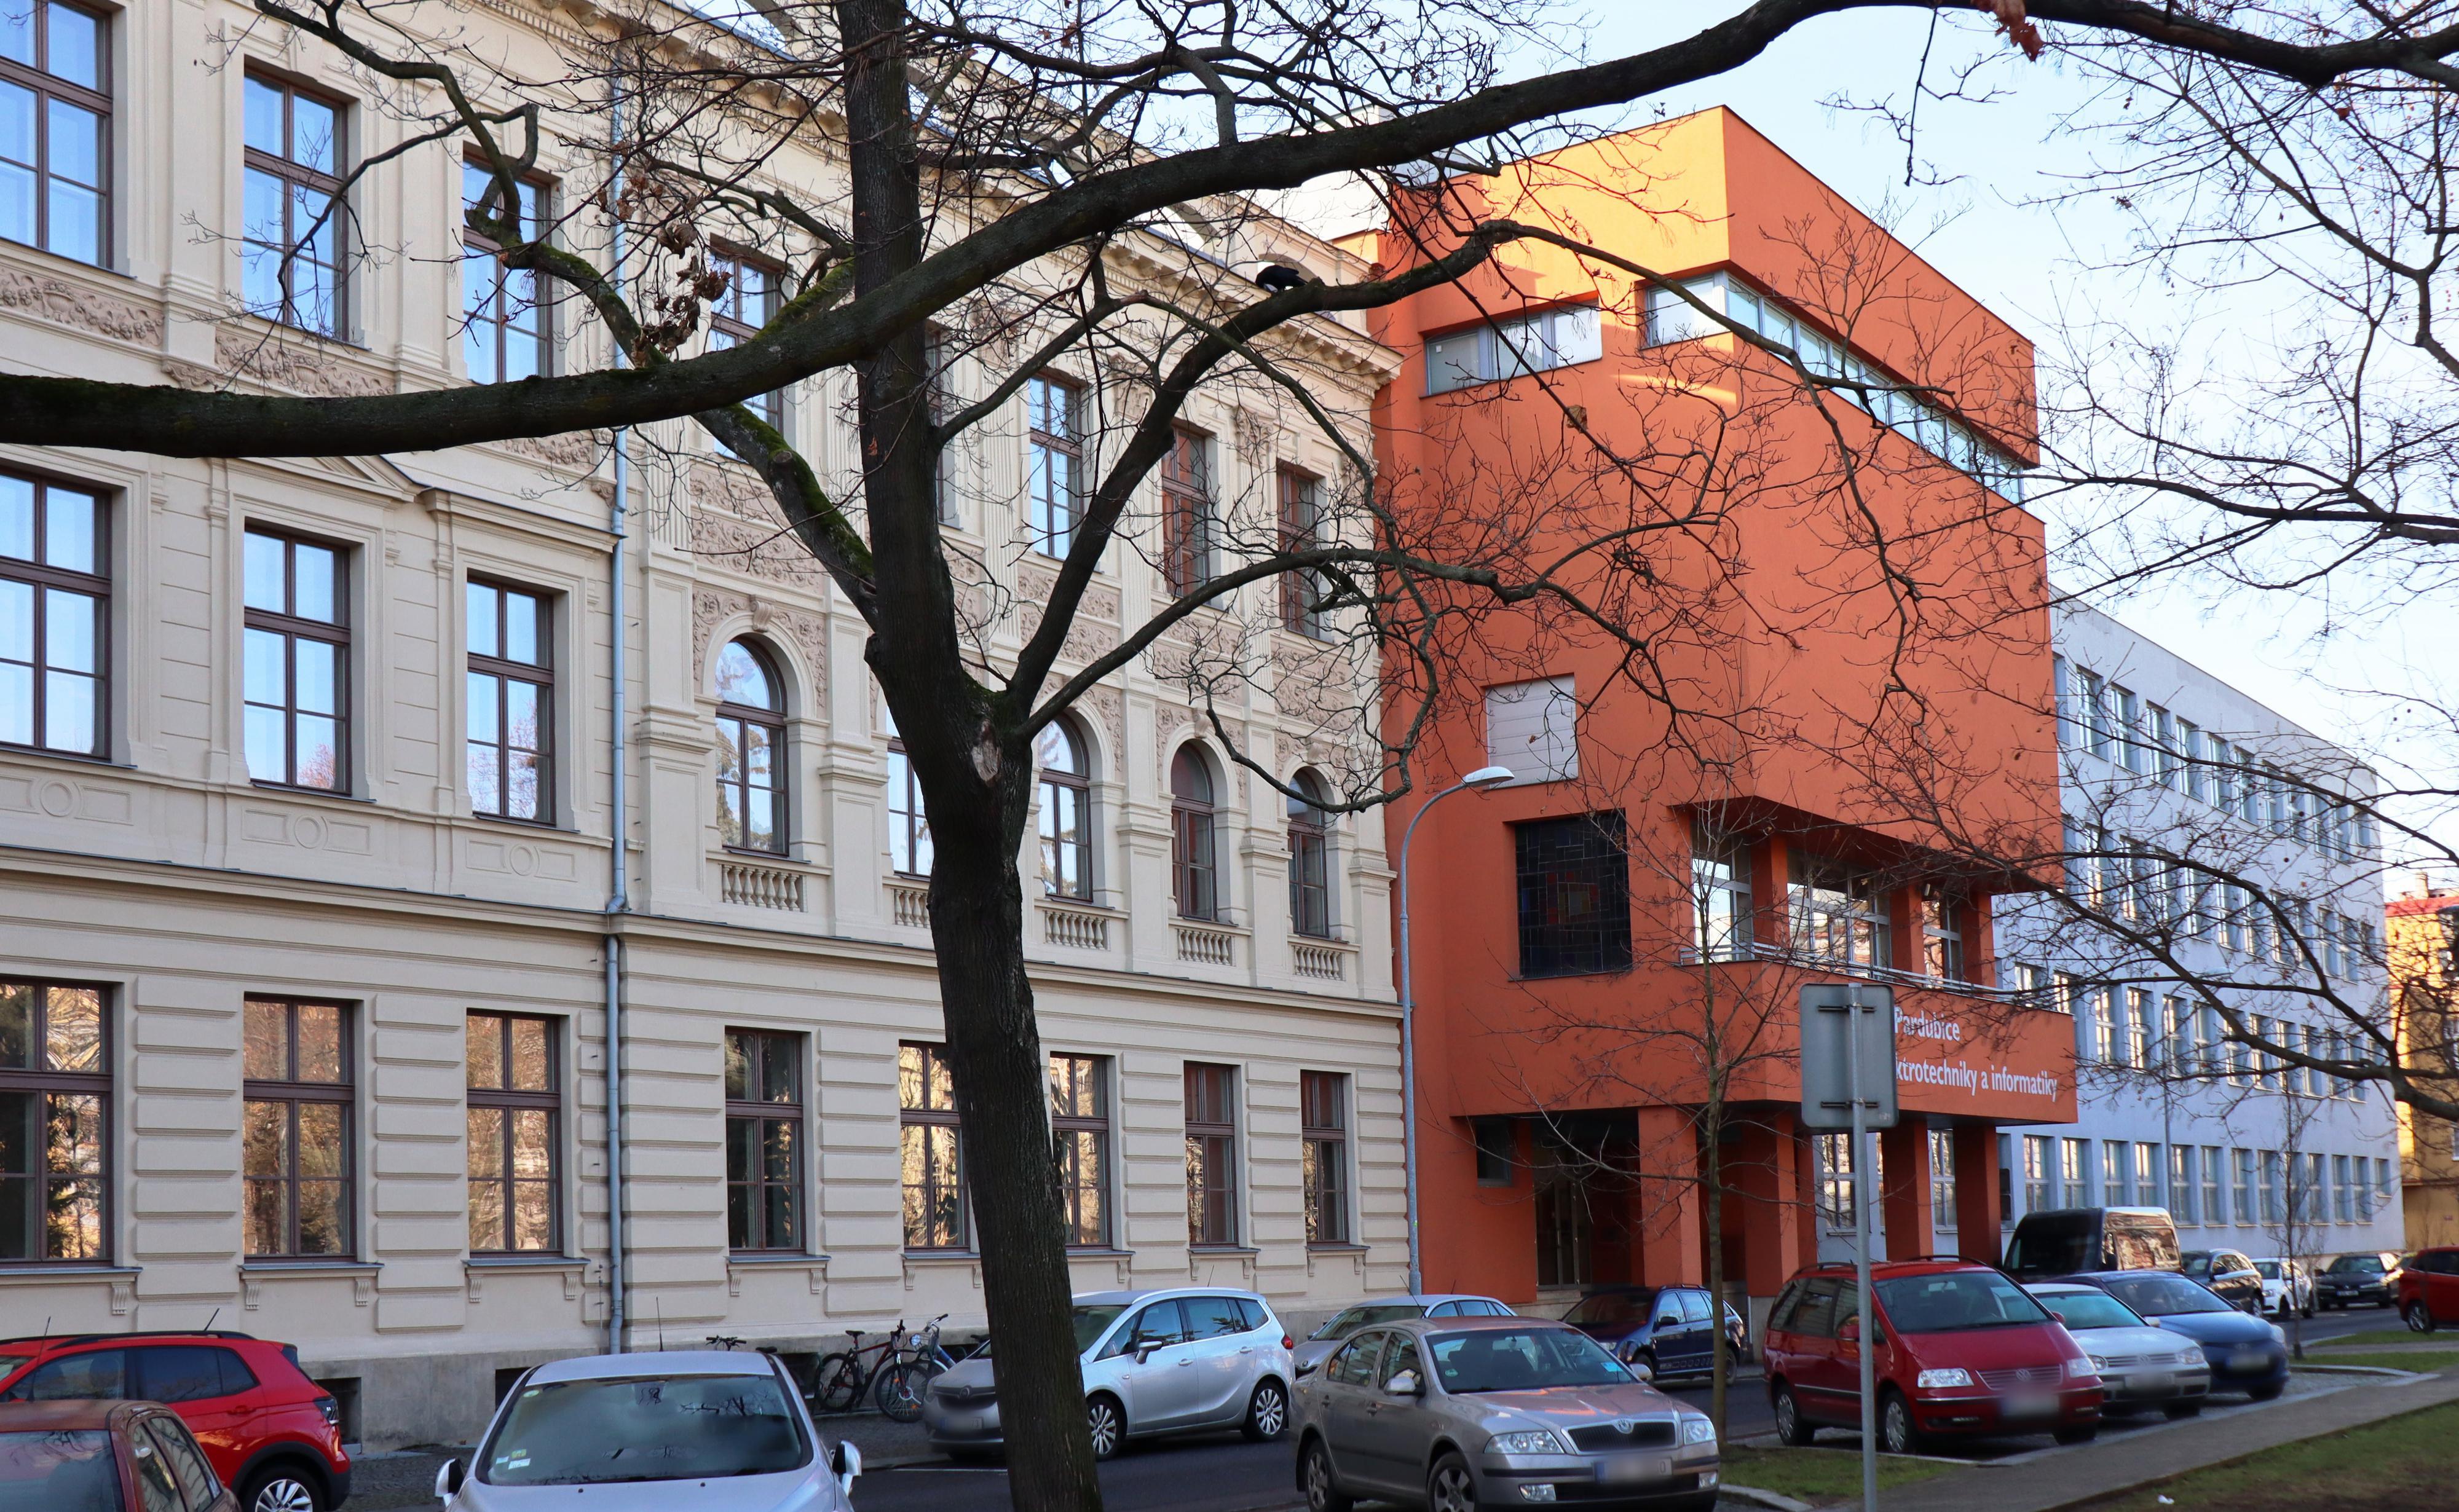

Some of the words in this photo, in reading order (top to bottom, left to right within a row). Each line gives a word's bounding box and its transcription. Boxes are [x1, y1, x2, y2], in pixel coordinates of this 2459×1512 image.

[1894, 1006, 1960, 1041] Pardubice
[1895, 1052, 1977, 1096] ktrotechniky
[1981, 1071, 1989, 1089] a
[1991, 1064, 2057, 1102] informatiky
